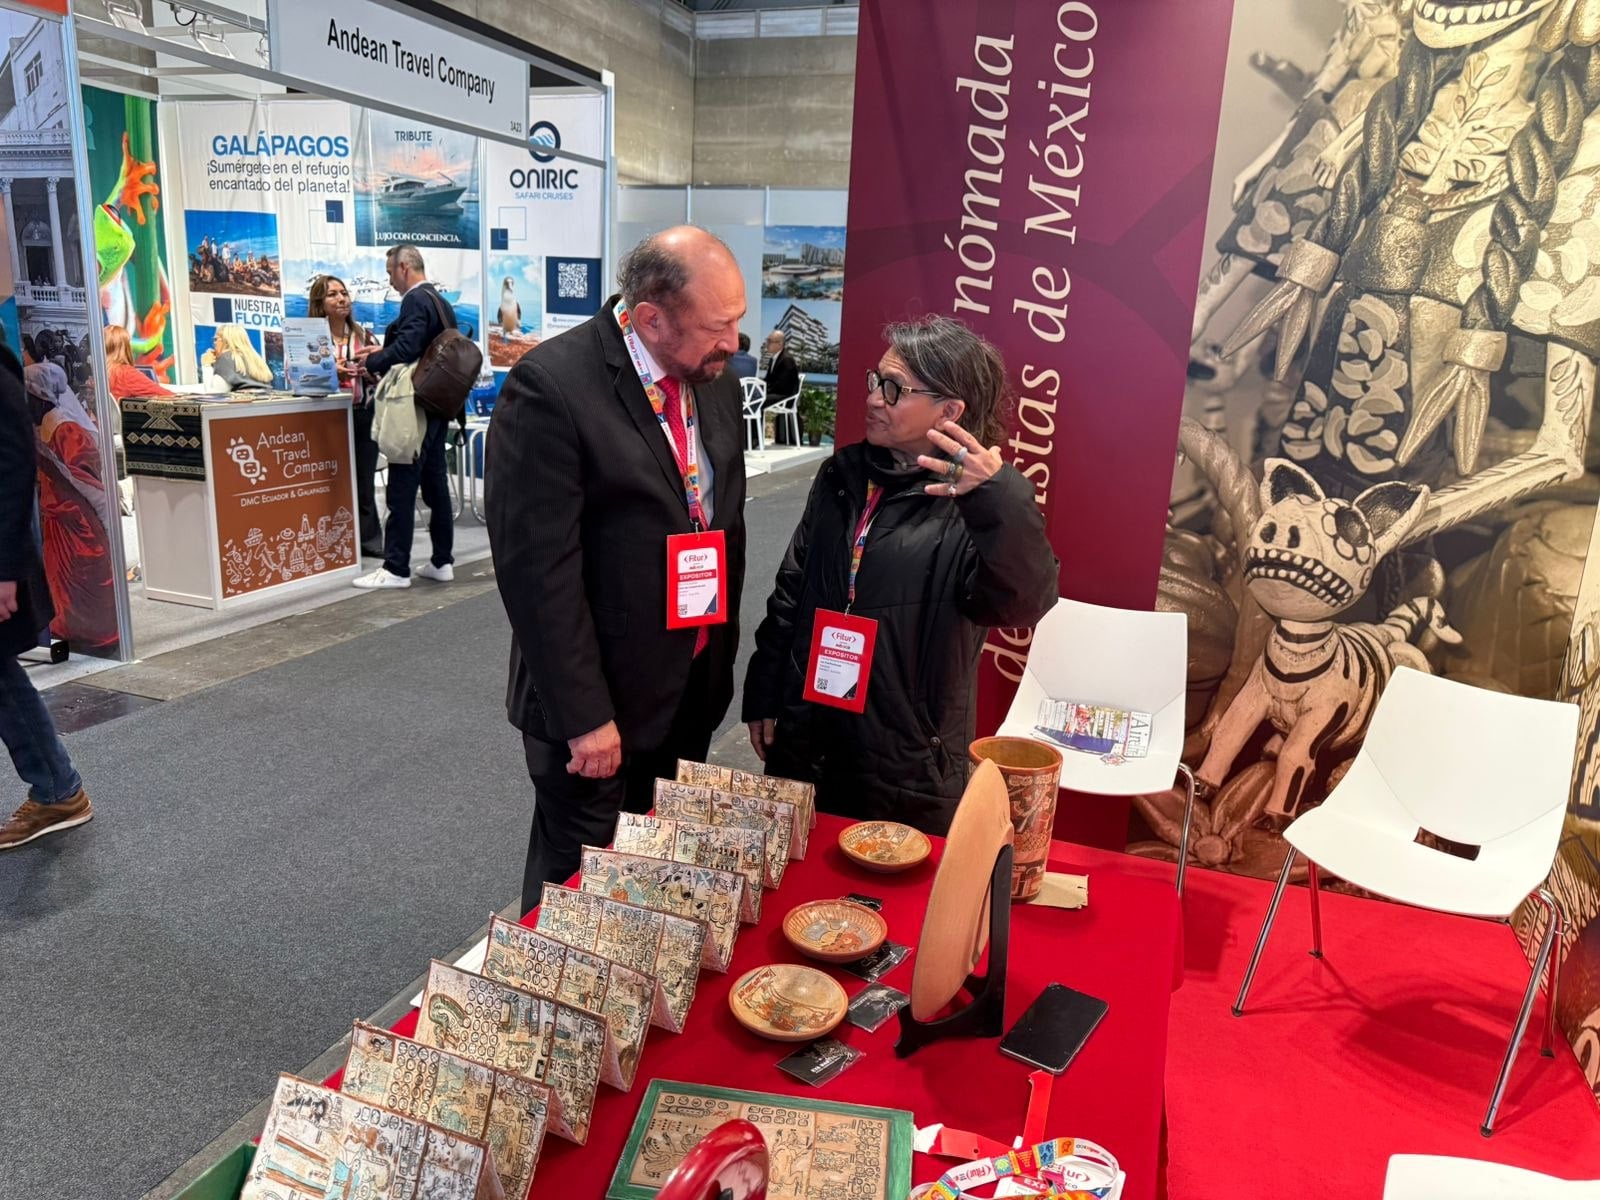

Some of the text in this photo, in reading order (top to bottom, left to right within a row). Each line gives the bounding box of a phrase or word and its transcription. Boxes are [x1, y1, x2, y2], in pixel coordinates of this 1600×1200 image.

[327, 18, 496, 103] Andean Travel Company
[1024, 1, 1099, 245] México
[212, 130, 350, 158] GALÁPAGOS
[394, 131, 433, 142] TRIBUTE
[206, 159, 350, 179] ¡Sumérgete en el refugio
[509, 168, 579, 190] ONIRIC
[944, 34, 1015, 315] nómada
[209, 177, 350, 195] encantado del planeta!
[515, 192, 574, 201] SAFARI CRUISES
[375, 231, 461, 243] LUJO CON CONCIENCIA.
[234, 298, 280, 313] NUESTRA
[1013, 266, 1071, 343] de
[235, 312, 282, 328] FLOTA
[257, 426, 305, 451] Andean
[272, 440, 310, 464] Travel
[283, 459, 338, 480] Company
[240, 496, 260, 507] DMC
[290, 489, 297, 499] &
[679, 571, 713, 581] EXPOSITOR
[824, 649, 859, 661] EXPOSITOR
